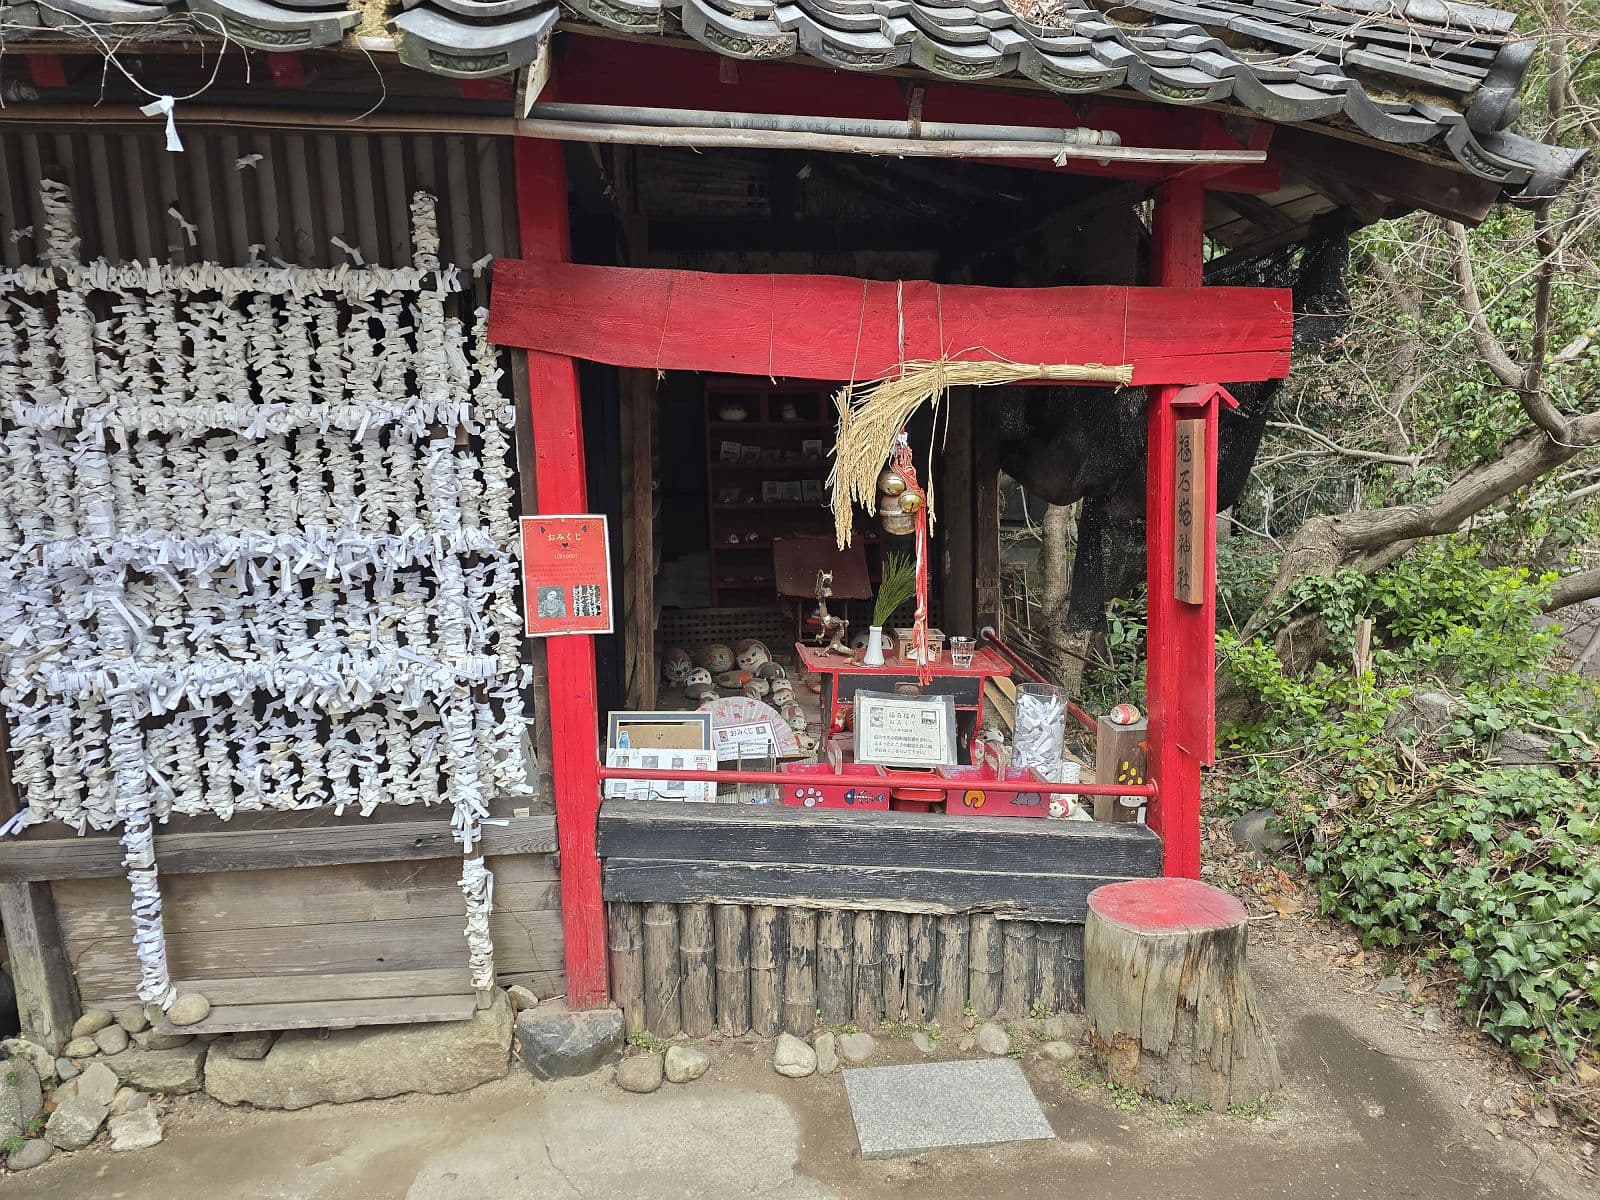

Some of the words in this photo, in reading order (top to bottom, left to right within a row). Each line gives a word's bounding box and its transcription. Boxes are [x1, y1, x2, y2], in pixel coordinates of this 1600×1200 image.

[1177, 435, 1192, 592] 福石猫神社
[547, 533, 582, 541] おみくじ
[730, 727, 754, 737] おみくじ
